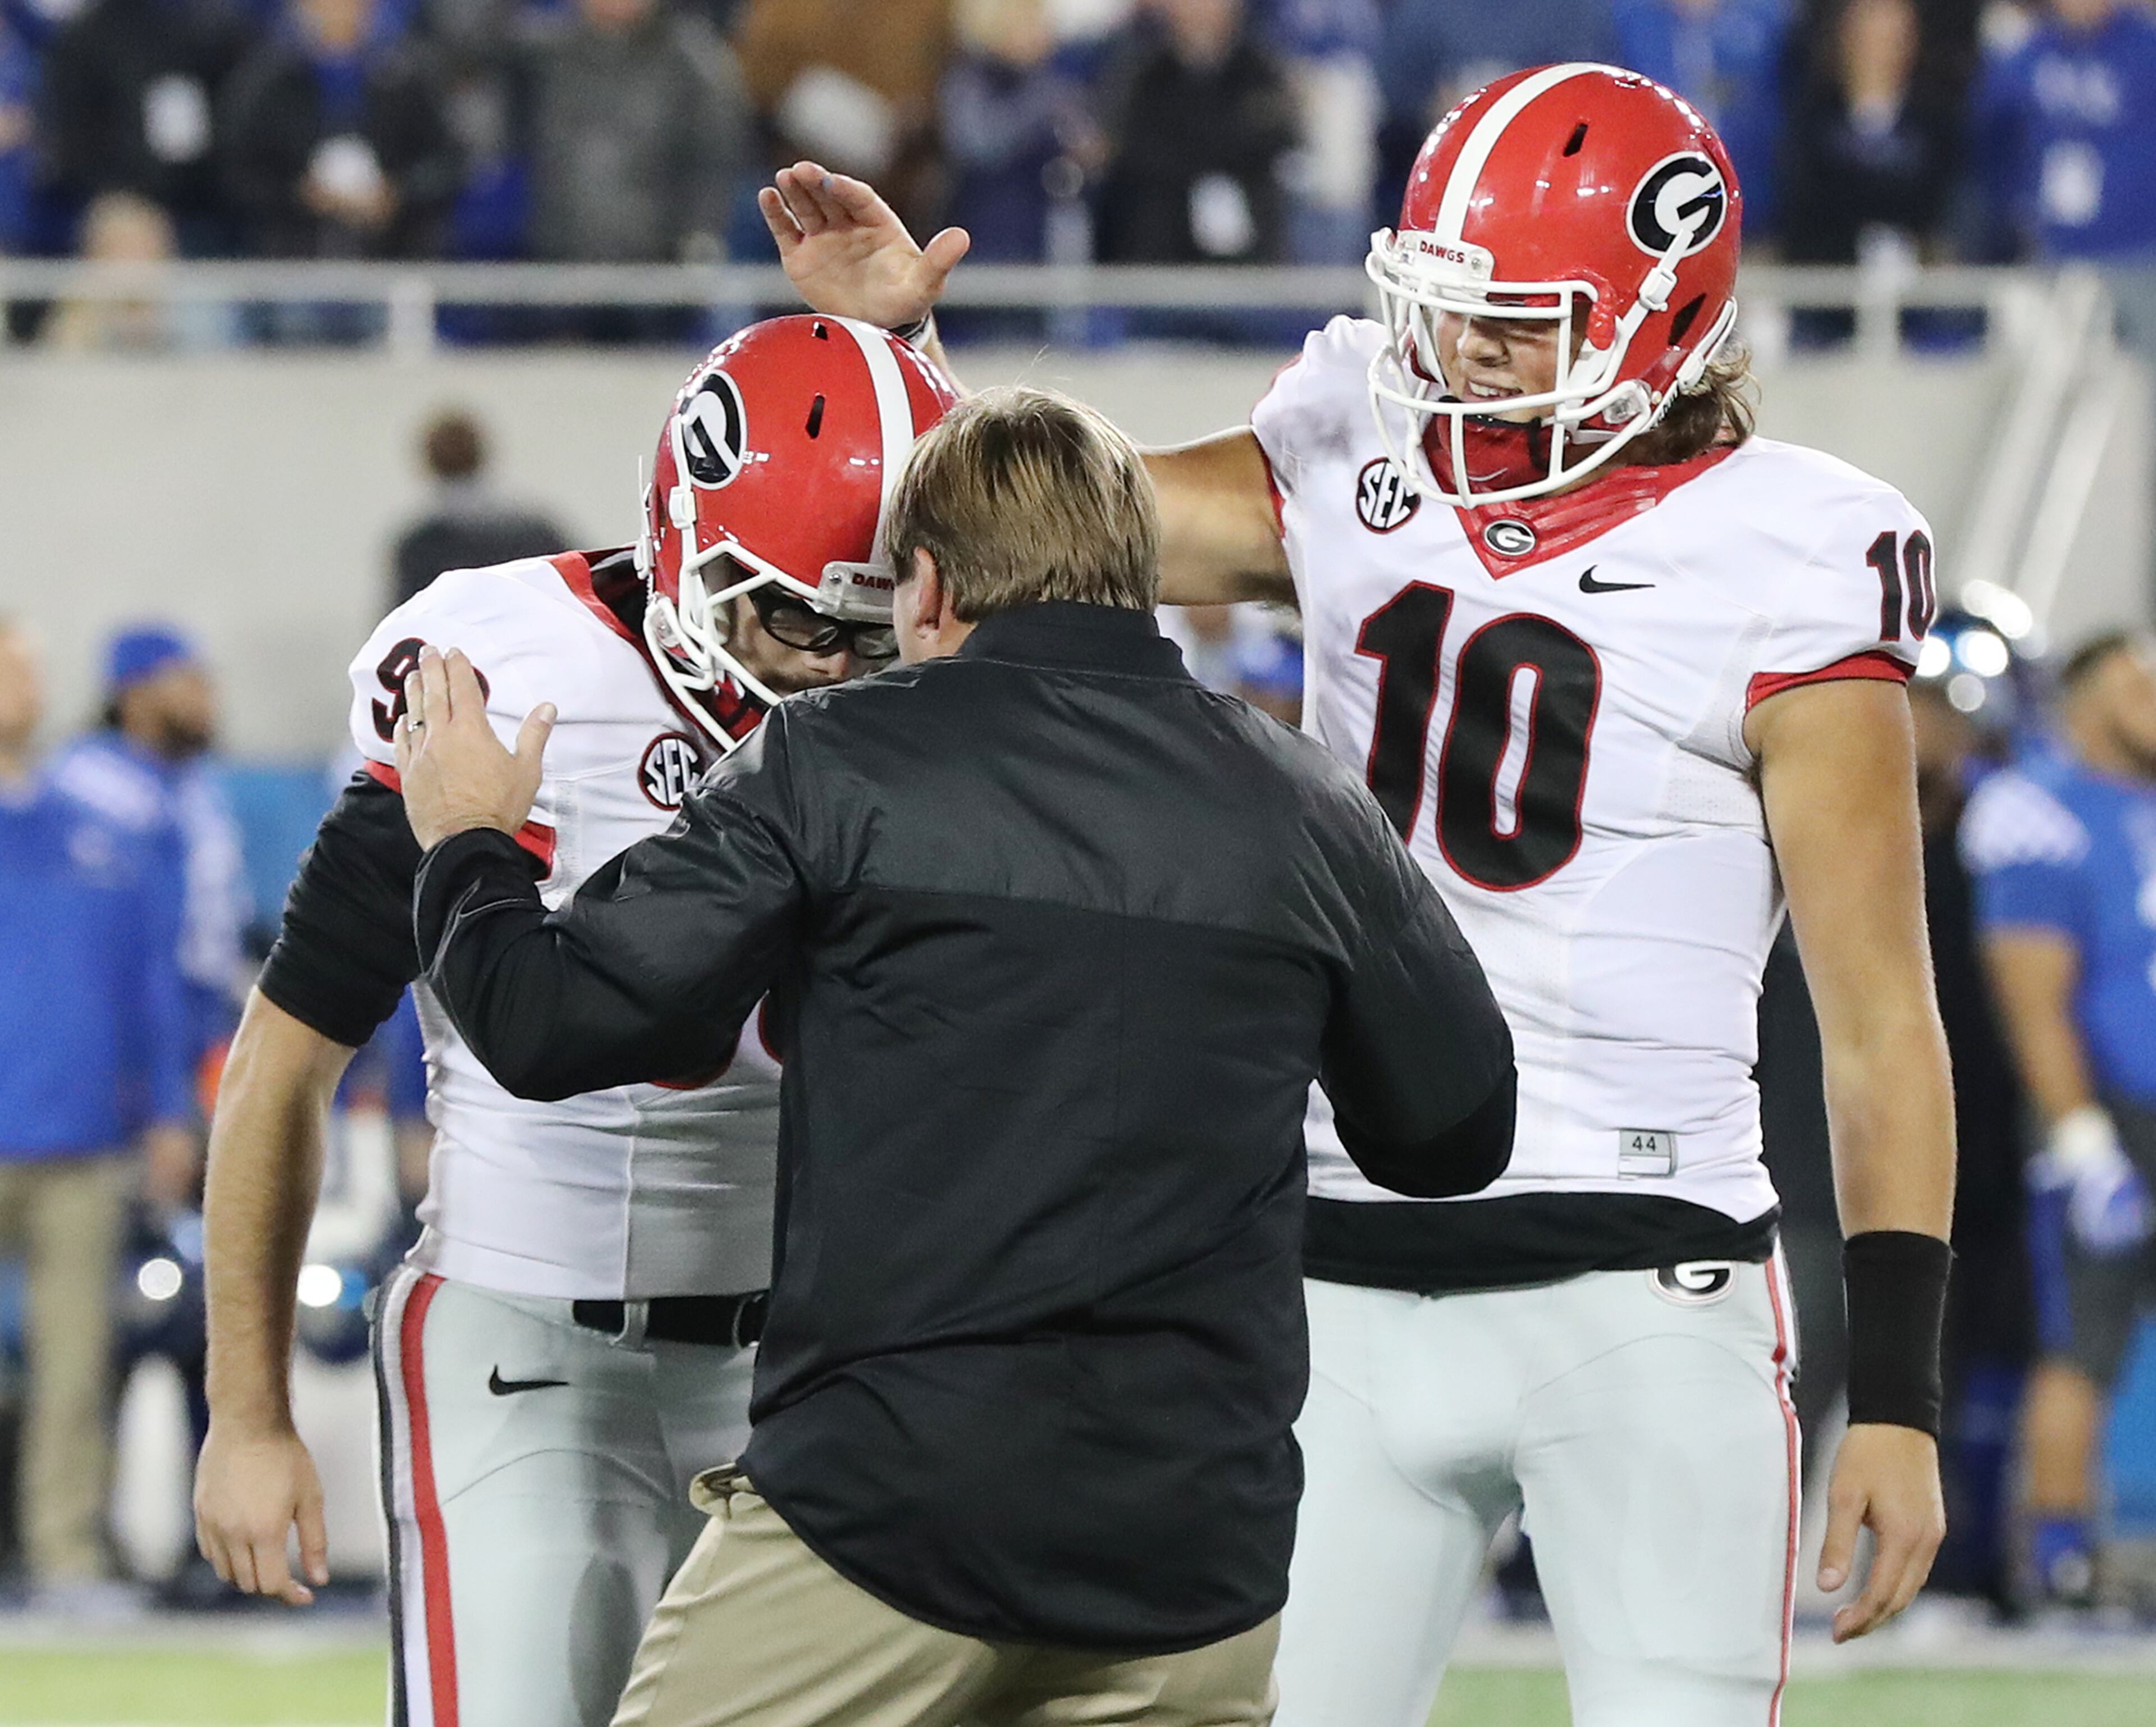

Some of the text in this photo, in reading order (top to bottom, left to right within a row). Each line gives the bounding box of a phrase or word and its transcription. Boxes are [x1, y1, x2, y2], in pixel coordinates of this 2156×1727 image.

[1632, 156, 1723, 252] G
[1420, 240, 1465, 263] DAWGS
[1354, 462, 1412, 529] SEC
[1486, 522, 1533, 554] G
[852, 572, 895, 591] DAW
[1866, 530, 1935, 641] 10
[1354, 579, 1604, 892] 10
[645, 738, 702, 806] SEC
[1632, 1135, 1657, 1153] 44
